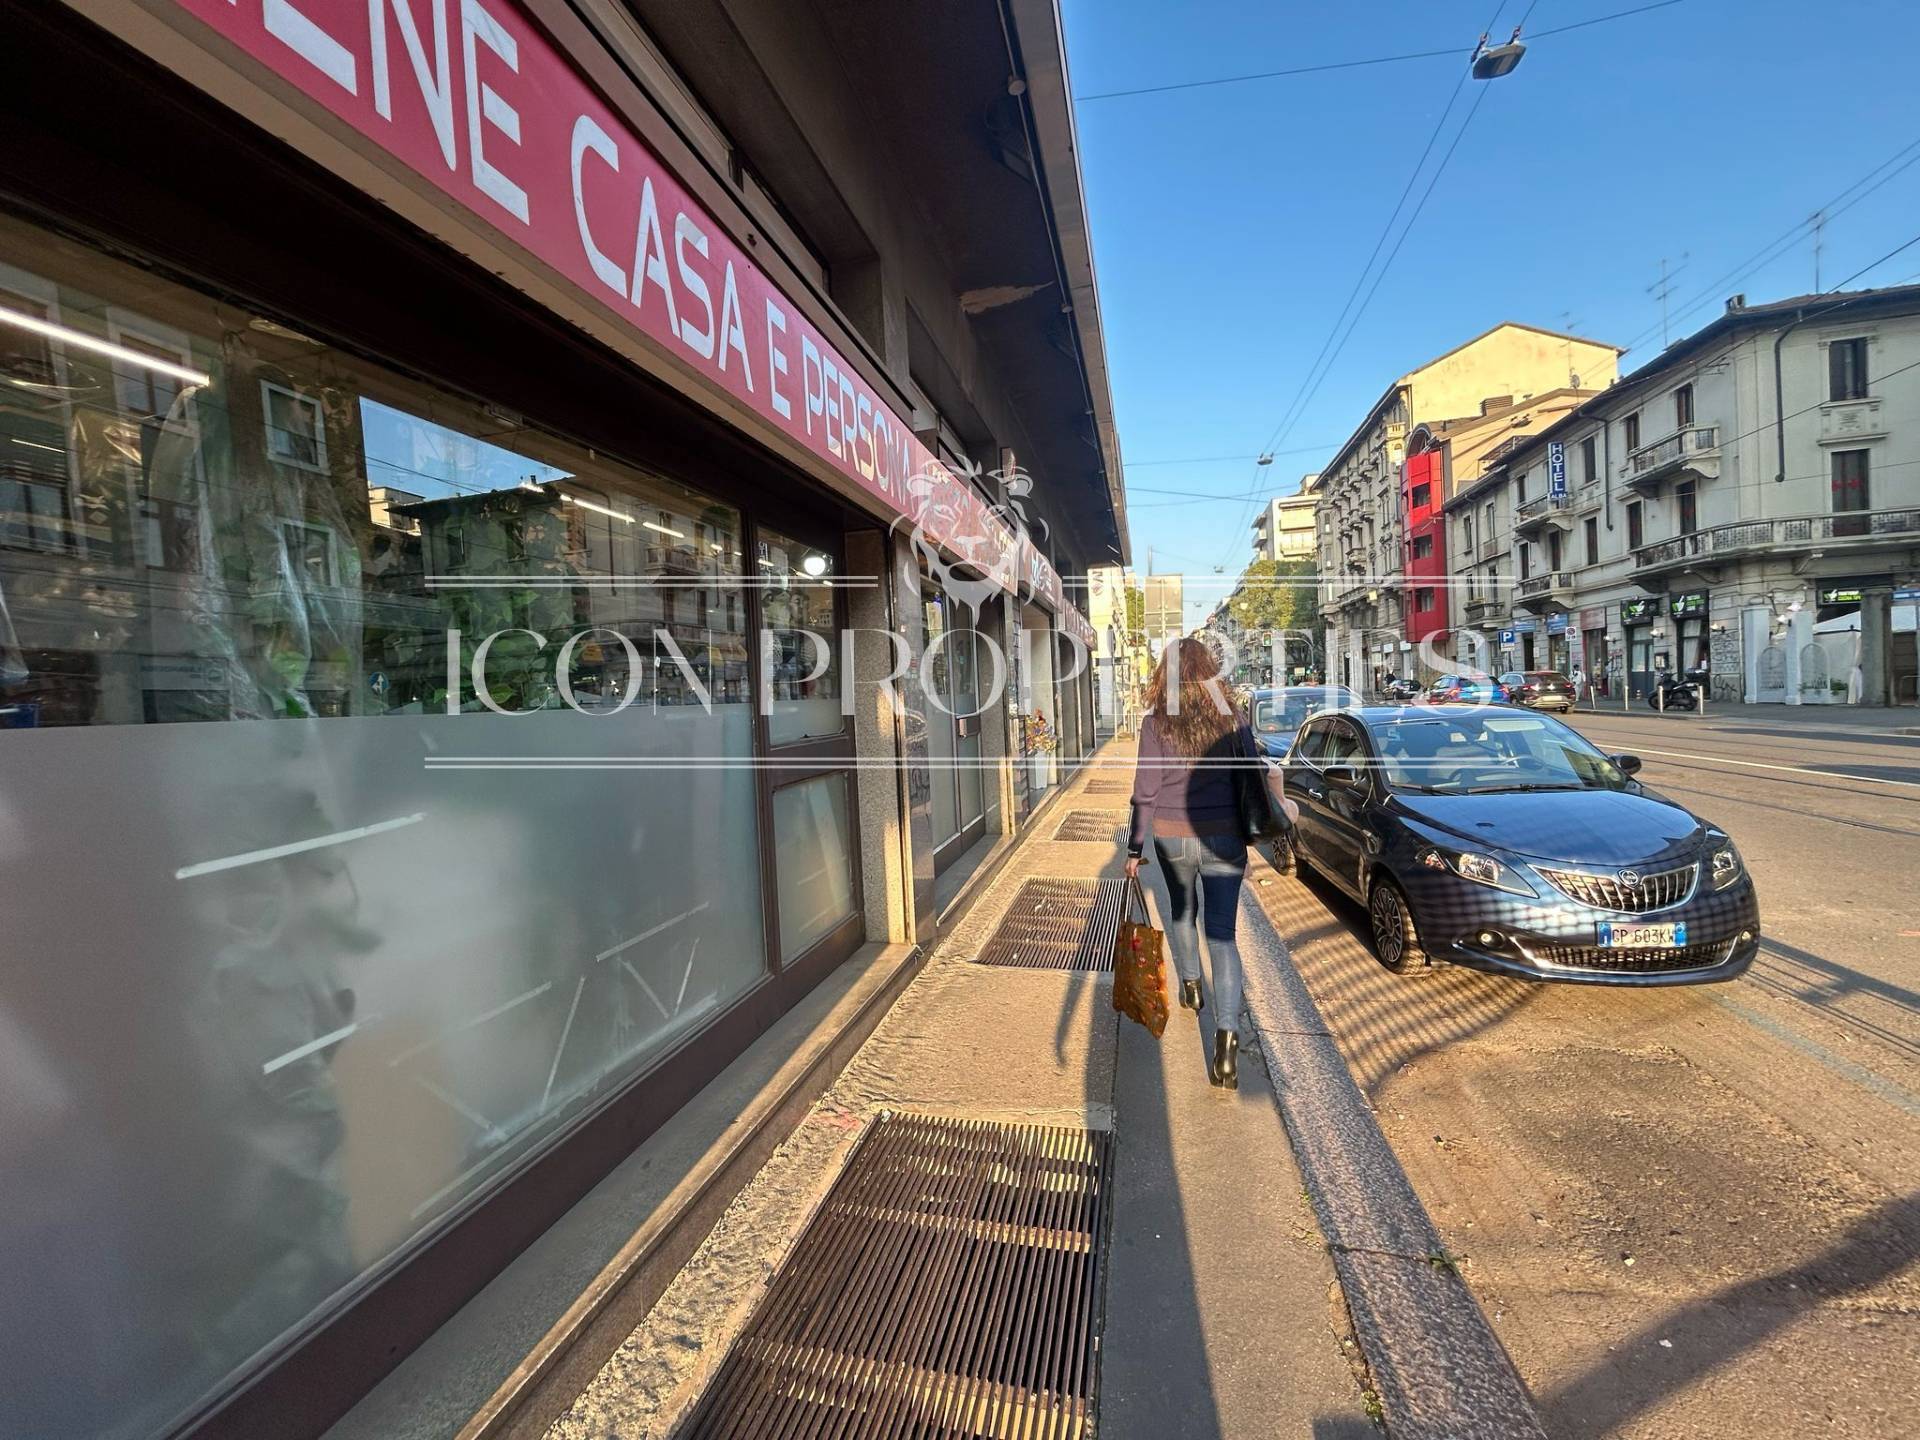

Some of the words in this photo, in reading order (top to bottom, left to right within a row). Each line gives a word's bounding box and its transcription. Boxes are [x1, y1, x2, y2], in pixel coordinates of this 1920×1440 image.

[570, 115, 754, 392] CASA
[766, 297, 791, 420] E
[802, 334, 915, 513] PERSONA
[1552, 444, 1564, 492] HOTEL
[1503, 631, 1512, 642] P
[1612, 929, 1628, 943] GP
